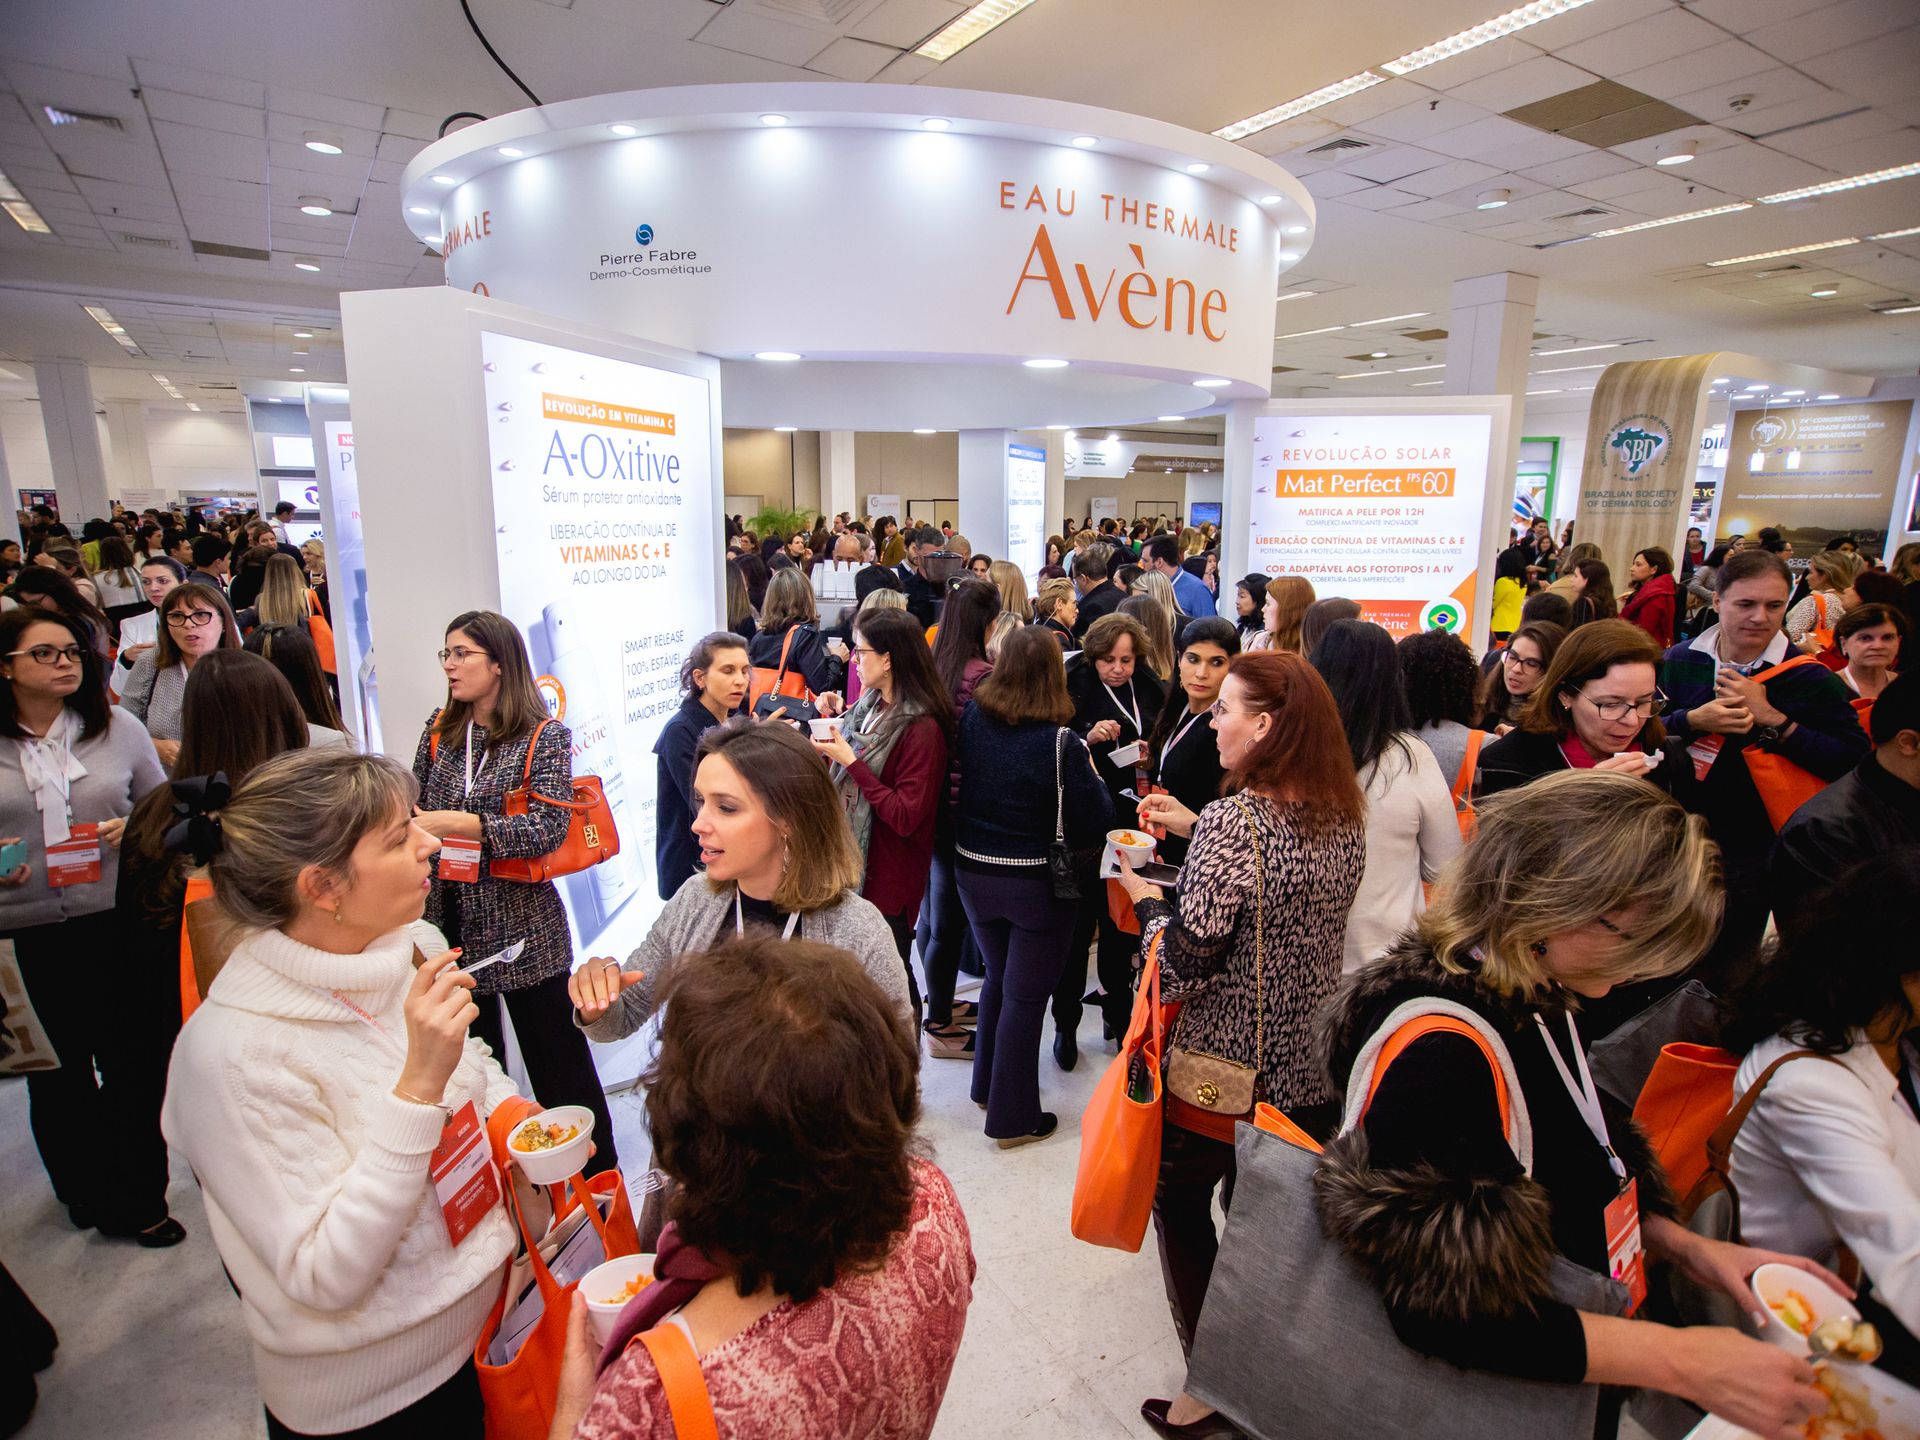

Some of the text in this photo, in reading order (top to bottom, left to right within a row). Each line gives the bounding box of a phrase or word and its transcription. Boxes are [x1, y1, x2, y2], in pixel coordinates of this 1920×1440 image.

[1000, 181, 1239, 252] EAU THERMALE
[600, 249, 697, 266] Pierre Fabre
[589, 264, 712, 281] Dermo-Cosmétique
[1006, 223, 1227, 342] Avène
[544, 399, 673, 429] REVOLUÇÃO EM VITAMINA C
[543, 429, 680, 484] A-OXitive
[1283, 446, 1452, 462] REVOLUÇÃO SOLAR
[1621, 438, 1656, 463] SBD
[1283, 471, 1448, 495] Mat Perfect FPS 60
[542, 484, 682, 508] Sérum protetor antioxidante
[1584, 489, 1679, 499] BRAZILIAN SOCIETY
[1298, 508, 1343, 517] MATIFICA
[1356, 508, 1377, 516] PELE
[1381, 508, 1401, 516] POR
[1405, 508, 1425, 517] 12H
[1586, 499, 1676, 508] OF DERMATOLOGY
[665, 523, 677, 537] DE
[1306, 519, 1418, 527] COMPLEXO MATIFICANTE INOVADOR
[1255, 534, 1465, 547] LIBERAÇÃO CONTÍNUA DE VITAMINAS C & E
[560, 543, 638, 564] VITAMINAS
[642, 543, 650, 560] C
[664, 542, 670, 558] E
[572, 564, 667, 585] AO LONGO DO DIA
[1265, 564, 1286, 574] COR
[1288, 563, 1344, 574] ADAPTÁVEL
[1346, 565, 1367, 574] AOS
[1370, 565, 1424, 574] FOTOTIPOS
[1433, 565, 1440, 574] A
[1443, 565, 1454, 574] IV
[624, 629, 684, 653] SMART RELEASE
[626, 660, 650, 677] 100%
[626, 682, 655, 700] MAIOR
[628, 704, 656, 724] MAIOR
